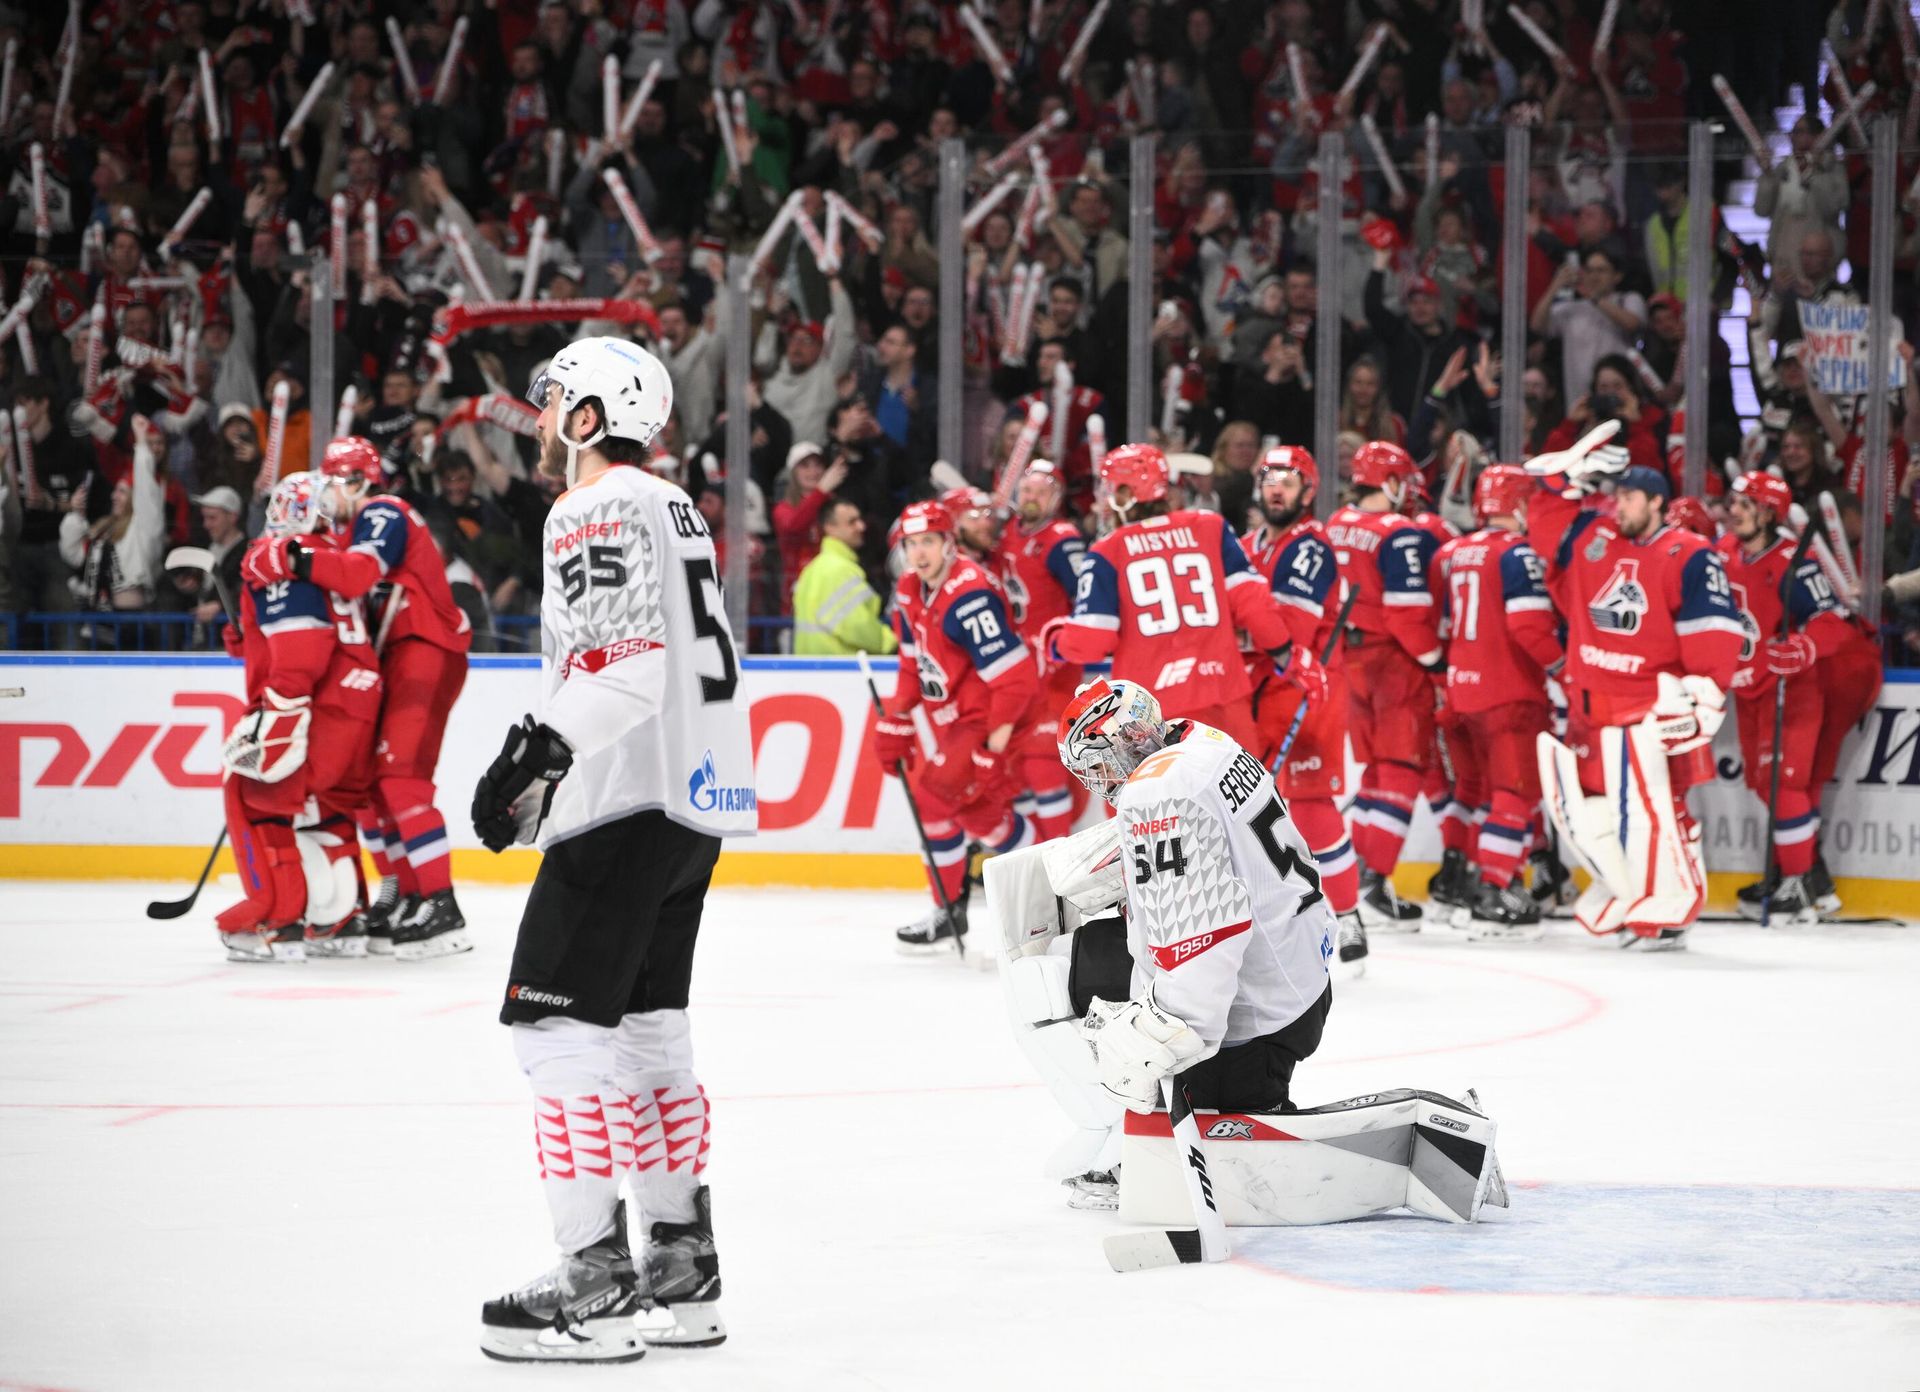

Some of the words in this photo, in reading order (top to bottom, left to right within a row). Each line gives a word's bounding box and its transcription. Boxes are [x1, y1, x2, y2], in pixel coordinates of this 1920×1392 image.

[370, 516, 389, 539] 7
[554, 522, 622, 557] FONBET
[1124, 527, 1198, 556] MISYUL
[558, 545, 627, 607] 55
[1404, 547, 1422, 574] 5
[1126, 556, 1219, 637] 93
[683, 558, 738, 702] 5
[962, 609, 1001, 645] 78
[602, 640, 650, 665] 1950
[1133, 816, 1180, 837] ONBET
[1171, 934, 1213, 962] 1950
[577, 1286, 622, 1320] CCM
